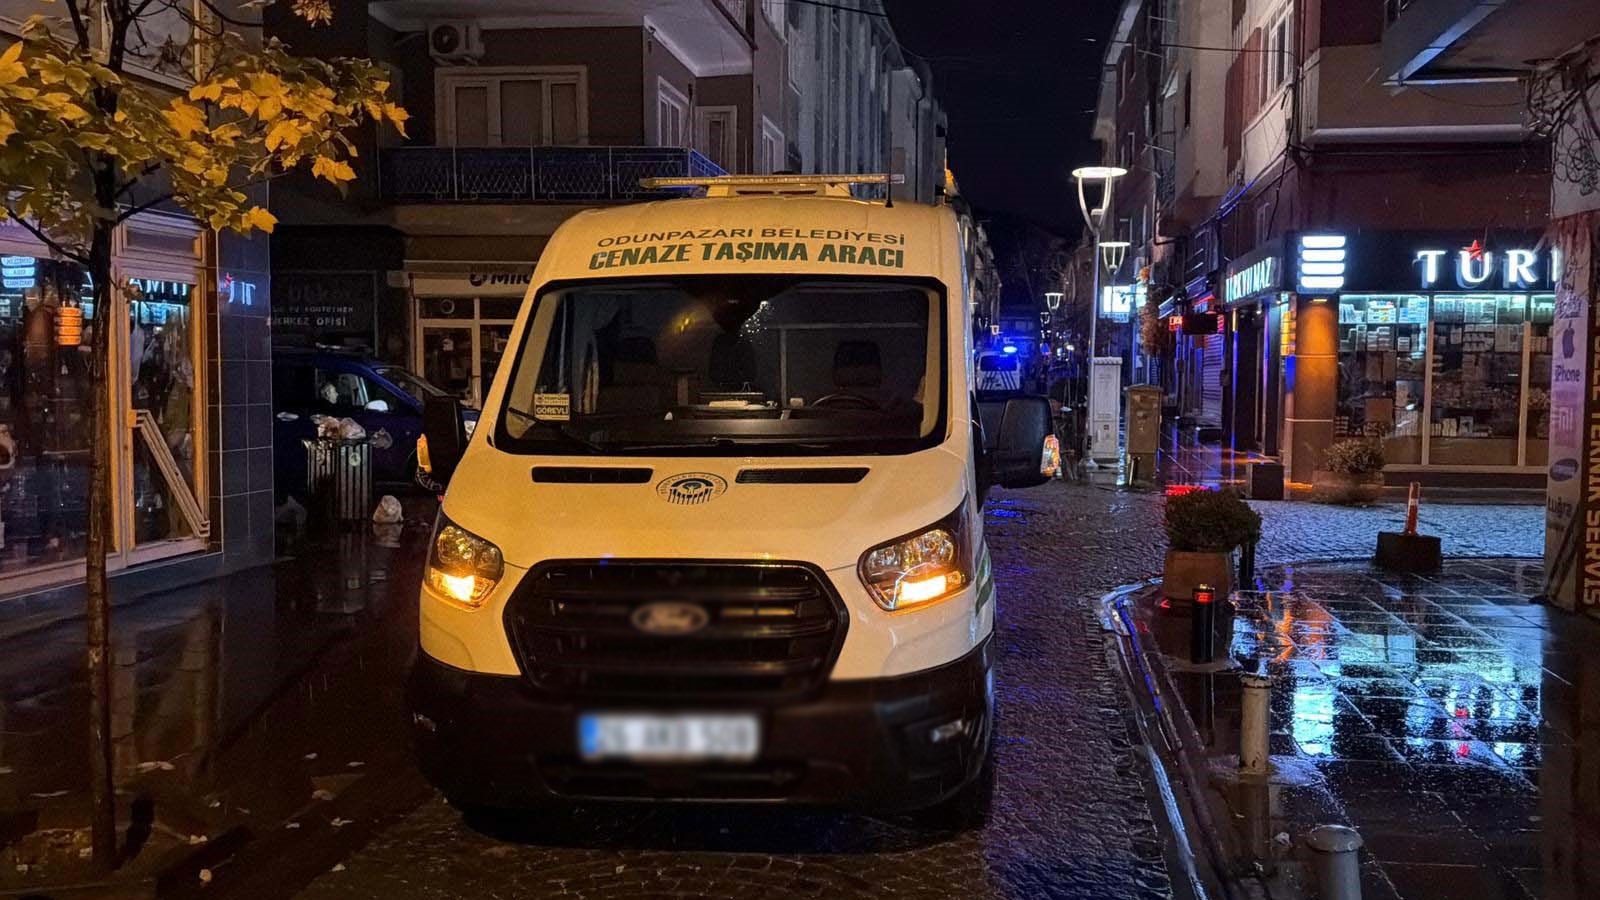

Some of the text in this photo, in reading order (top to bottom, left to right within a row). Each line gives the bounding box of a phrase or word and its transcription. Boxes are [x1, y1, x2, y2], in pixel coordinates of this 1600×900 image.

[597, 228, 905, 248] ODUNPAZARI BELEDİYESİ
[589, 241, 904, 270] CENAZE TAŞIMA ARACI
